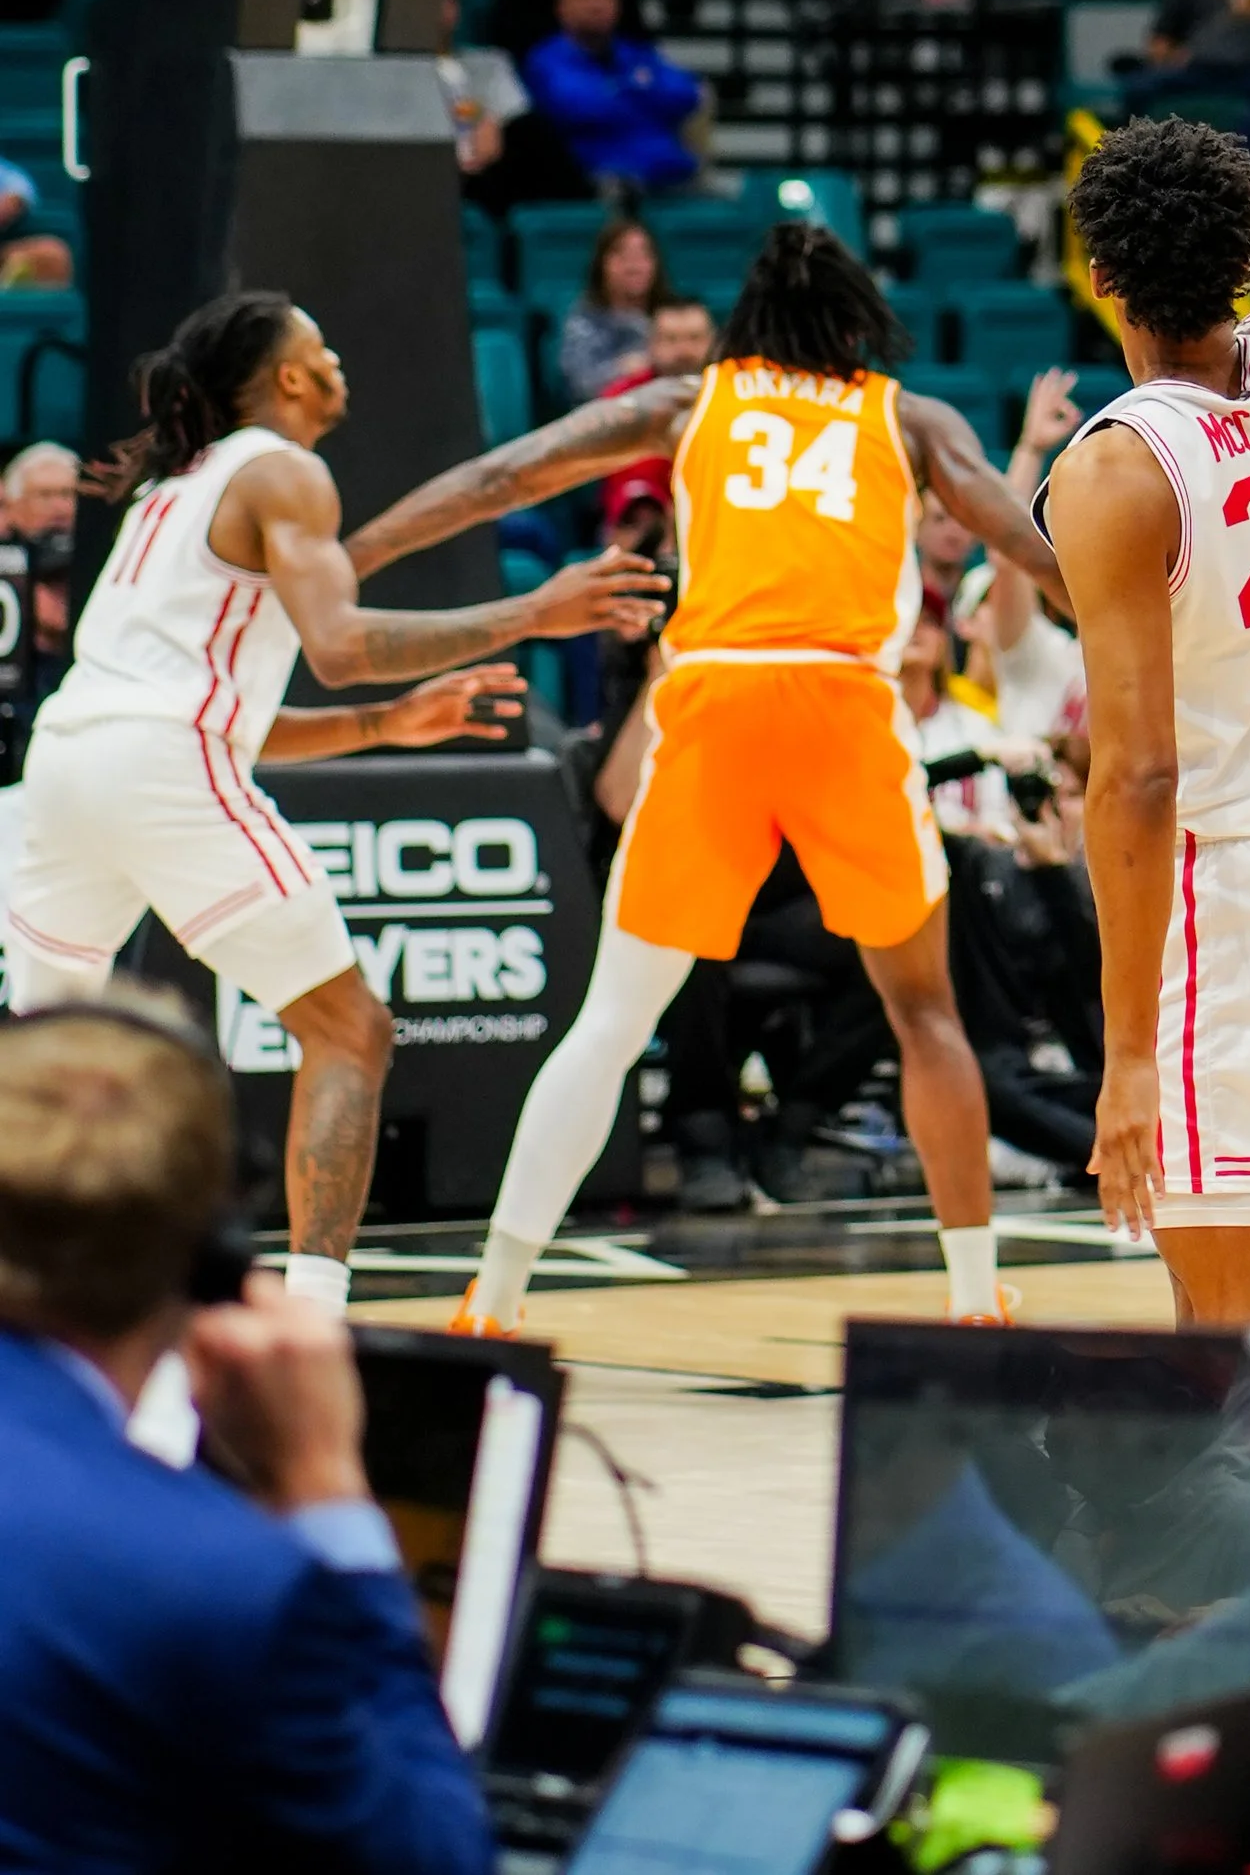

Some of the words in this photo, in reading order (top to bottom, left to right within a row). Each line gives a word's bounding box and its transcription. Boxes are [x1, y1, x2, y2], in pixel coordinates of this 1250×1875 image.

[725, 411, 858, 521] 34
[286, 817, 539, 898] EICO
[352, 923, 544, 1003] YERS
